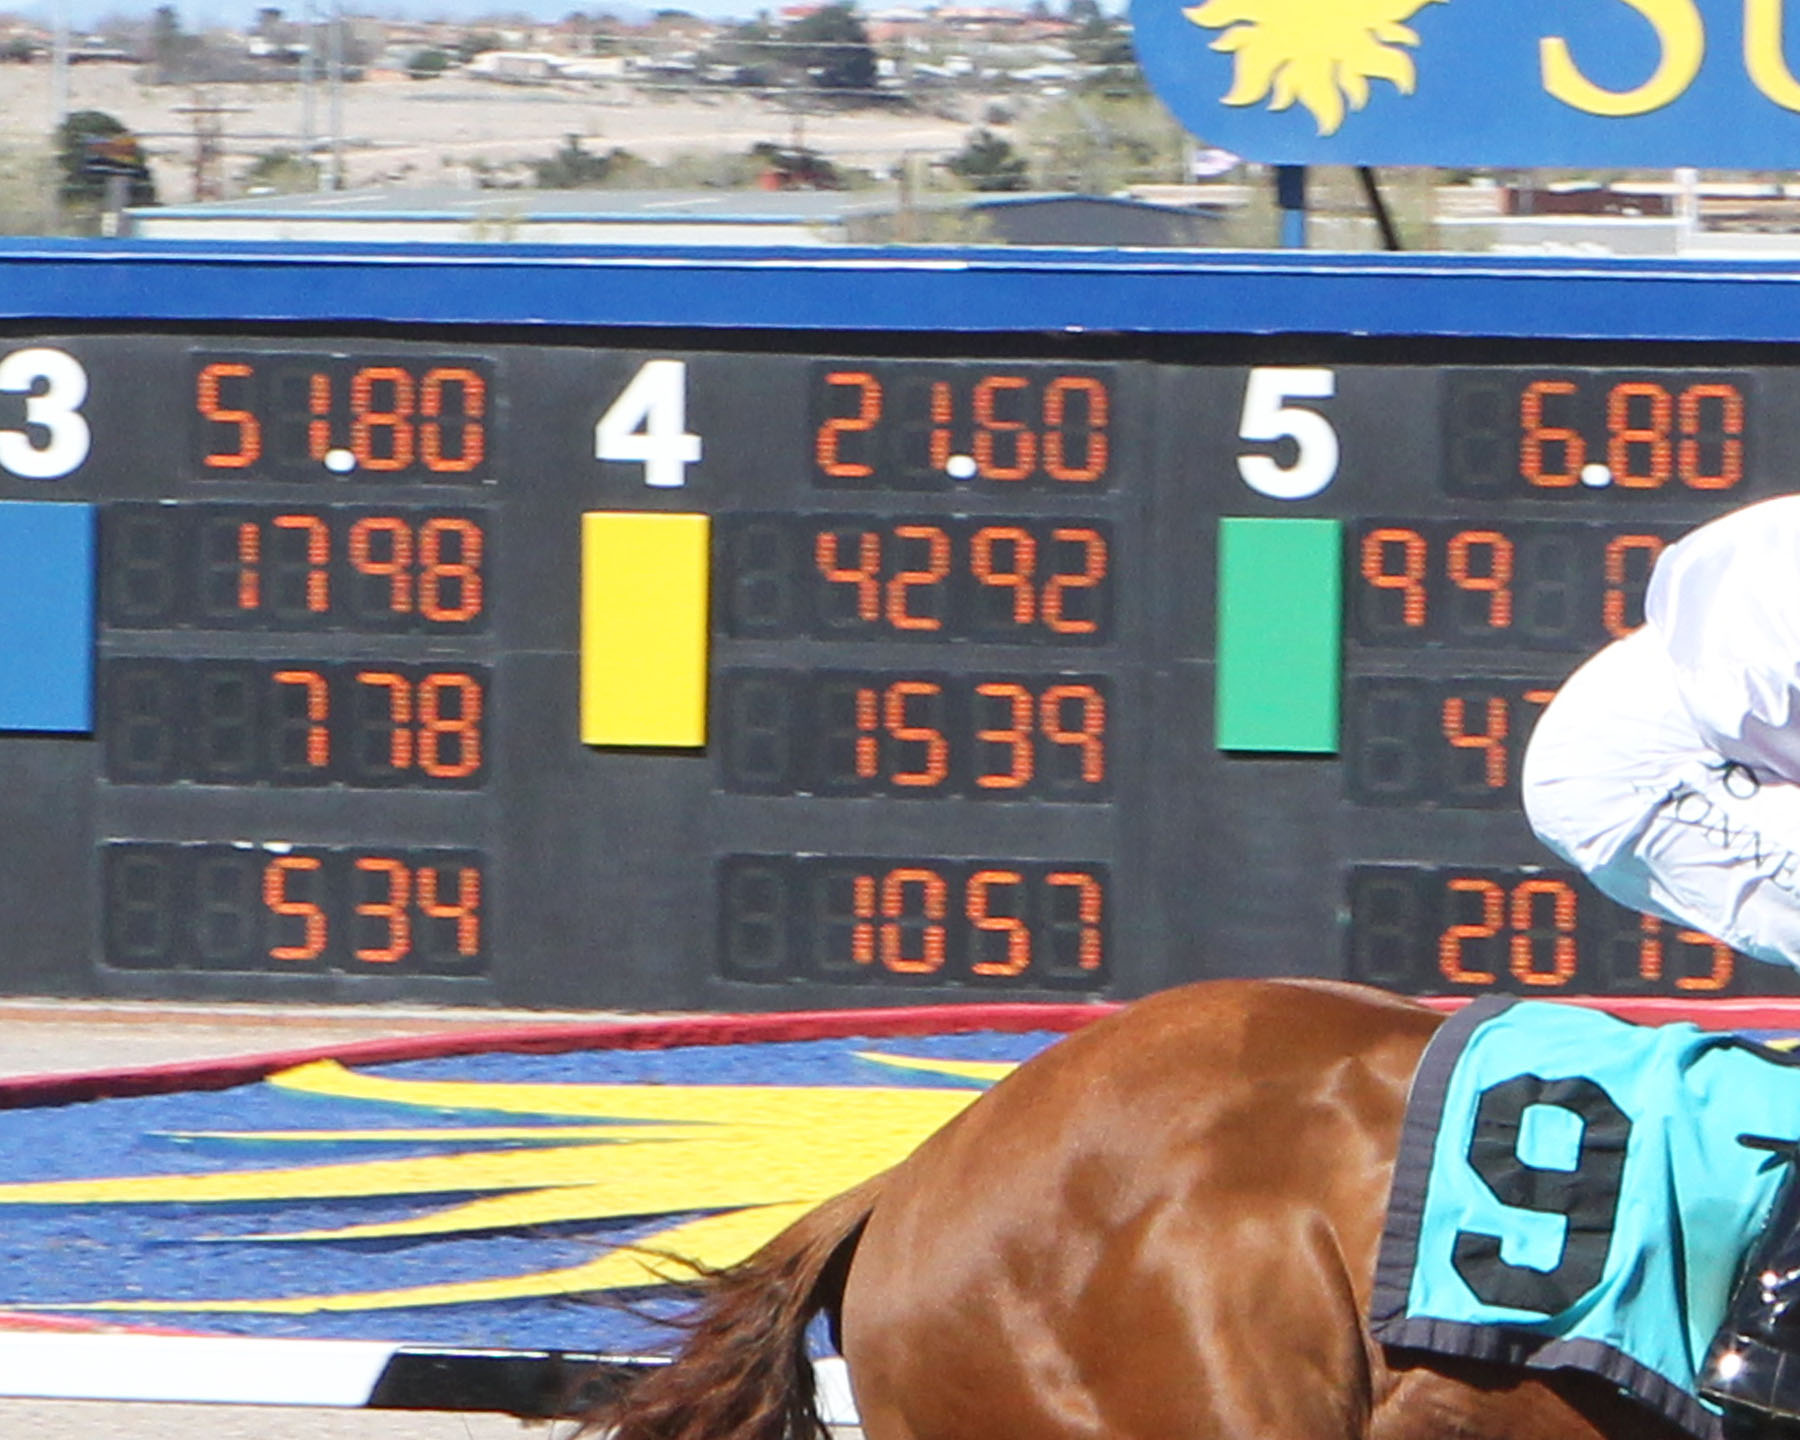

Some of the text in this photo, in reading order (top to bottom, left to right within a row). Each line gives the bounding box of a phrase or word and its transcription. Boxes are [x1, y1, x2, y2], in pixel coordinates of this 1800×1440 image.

[0, 347, 90, 479] 3
[595, 359, 703, 487] 4
[1237, 366, 1340, 500] 5
[238, 514, 484, 623] 1798
[816, 524, 1108, 634] 4292
[272, 670, 482, 779] 778
[855, 680, 1106, 789] 1539
[1443, 692, 1553, 788] 4
[263, 856, 480, 964] 534
[852, 867, 1102, 977] 1057
[1451, 1072, 1634, 1315] 9
